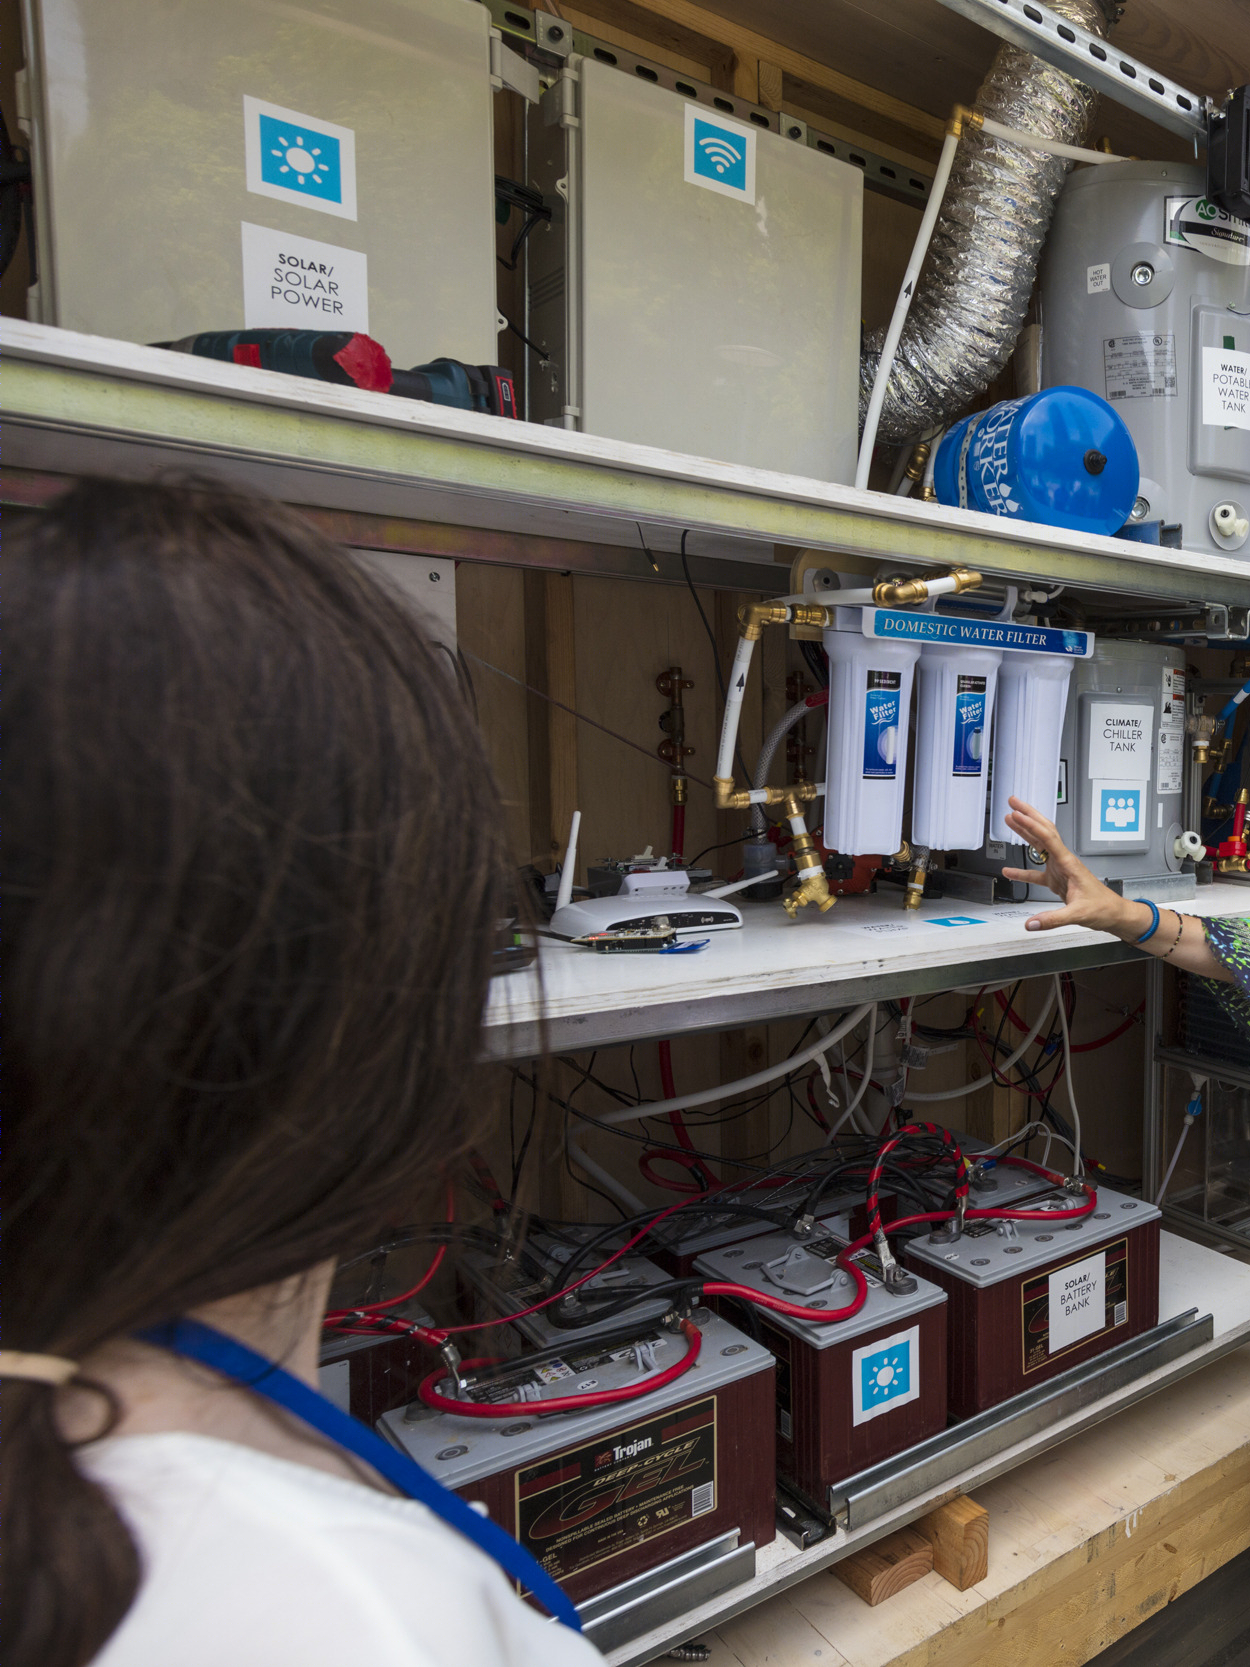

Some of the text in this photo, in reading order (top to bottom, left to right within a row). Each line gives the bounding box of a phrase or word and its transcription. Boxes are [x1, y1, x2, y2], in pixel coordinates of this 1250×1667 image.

[278, 253, 334, 277] SOLAR/
[273, 267, 339, 297] SOLAR
[1090, 274, 1107, 282] WATER
[271, 285, 344, 315] POWER
[1220, 363, 1248, 376] WATER/
[1217, 387, 1250, 401] WATER
[1221, 400, 1247, 413] TANK
[884, 618, 1047, 646] DOMESTIC WATER FILTER
[869, 700, 896, 714] Water
[873, 707, 897, 720] Filter
[959, 701, 982, 714] Water
[962, 707, 983, 720] Filter
[1105, 718, 1142, 728] CLIMATE/
[1103, 728, 1143, 740] CHILLER
[1109, 741, 1136, 752] TANK
[1064, 1272, 1091, 1291] SOLAR/
[1060, 1280, 1097, 1306] BATTERY
[1065, 1296, 1090, 1316] BANK
[613, 1437, 652, 1461] Trojan
[593, 1440, 696, 1487] DEEP-CYCLE
[529, 1437, 706, 1540] GEL
